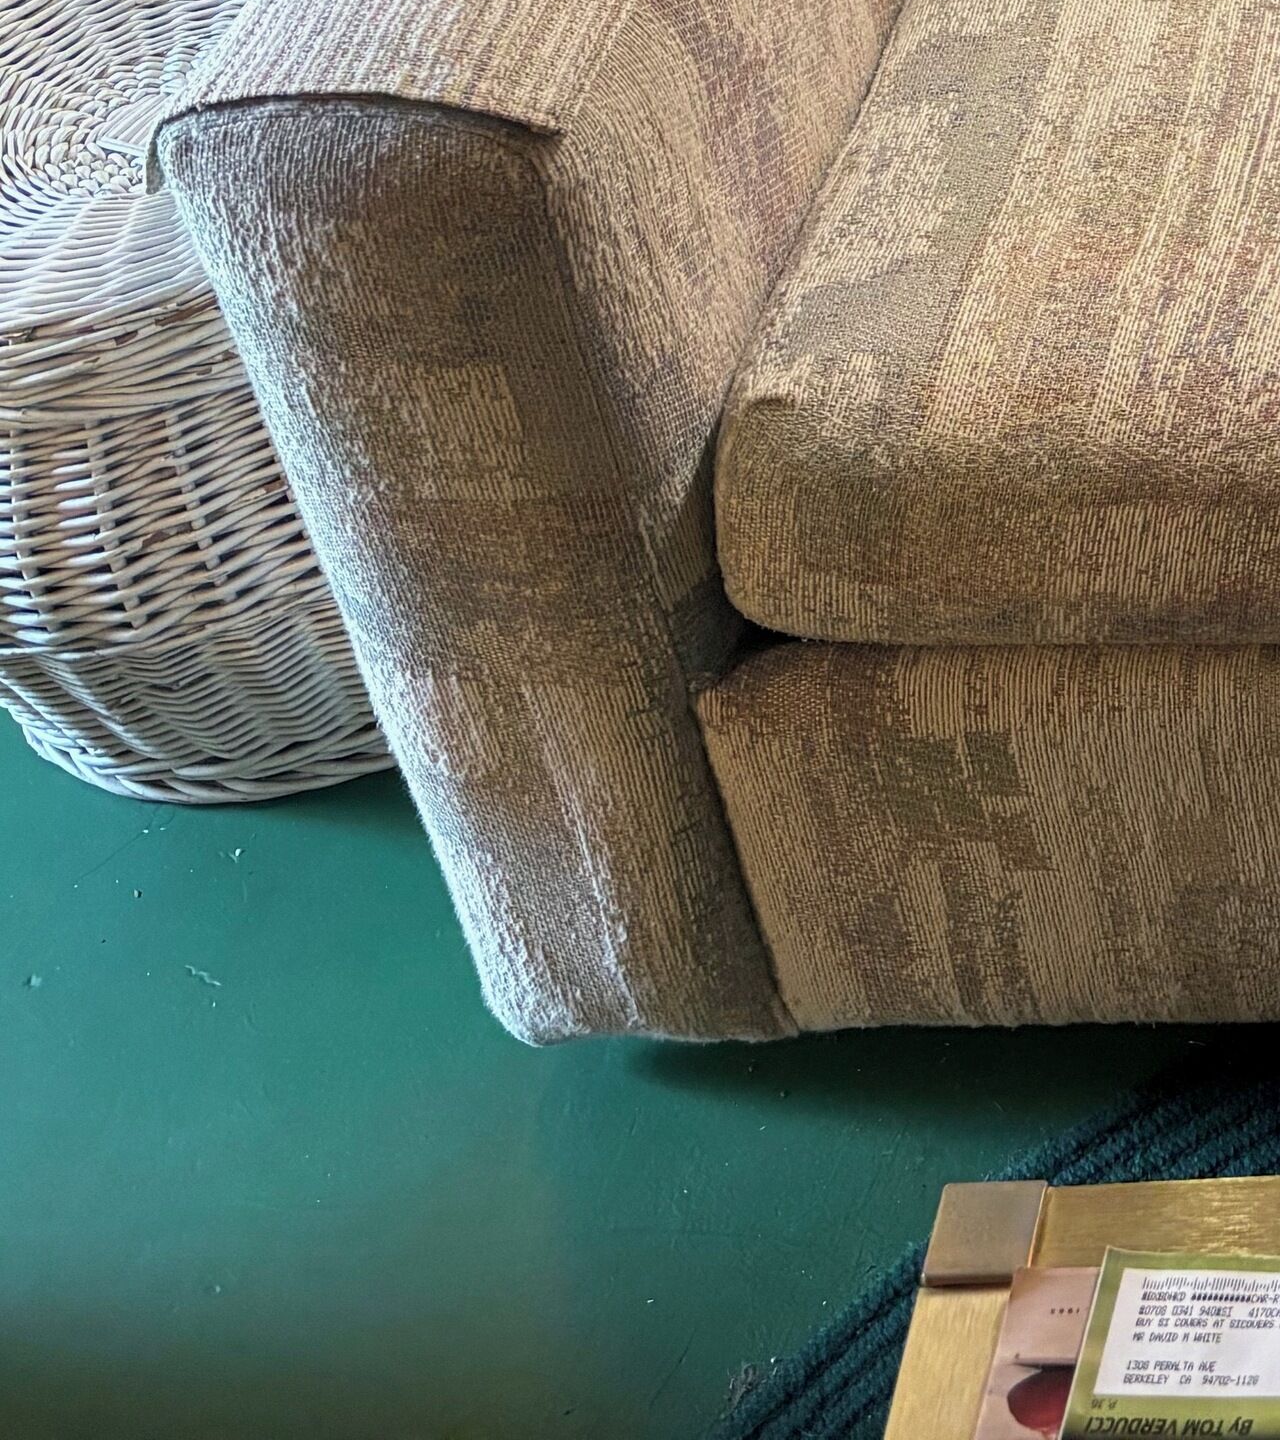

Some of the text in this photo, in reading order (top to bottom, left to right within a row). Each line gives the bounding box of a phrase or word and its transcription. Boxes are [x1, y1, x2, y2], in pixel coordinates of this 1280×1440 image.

[1135, 1317, 1153, 1327] BUY
[1174, 1317, 1208, 1328] COVERS
[1213, 1318, 1223, 1327] AT
[1132, 1332, 1145, 1342] MR
[1149, 1333, 1178, 1343] DAVID
[1193, 1333, 1223, 1344] WHITE
[1153, 1361, 1194, 1371] PERALTA
[1199, 1361, 1217, 1371] AVE
[1123, 1374, 1169, 1385] BERKELEY
[1179, 1375, 1192, 1385] CA
[1084, 1416, 1253, 1437] By TOM VERDUCCI
